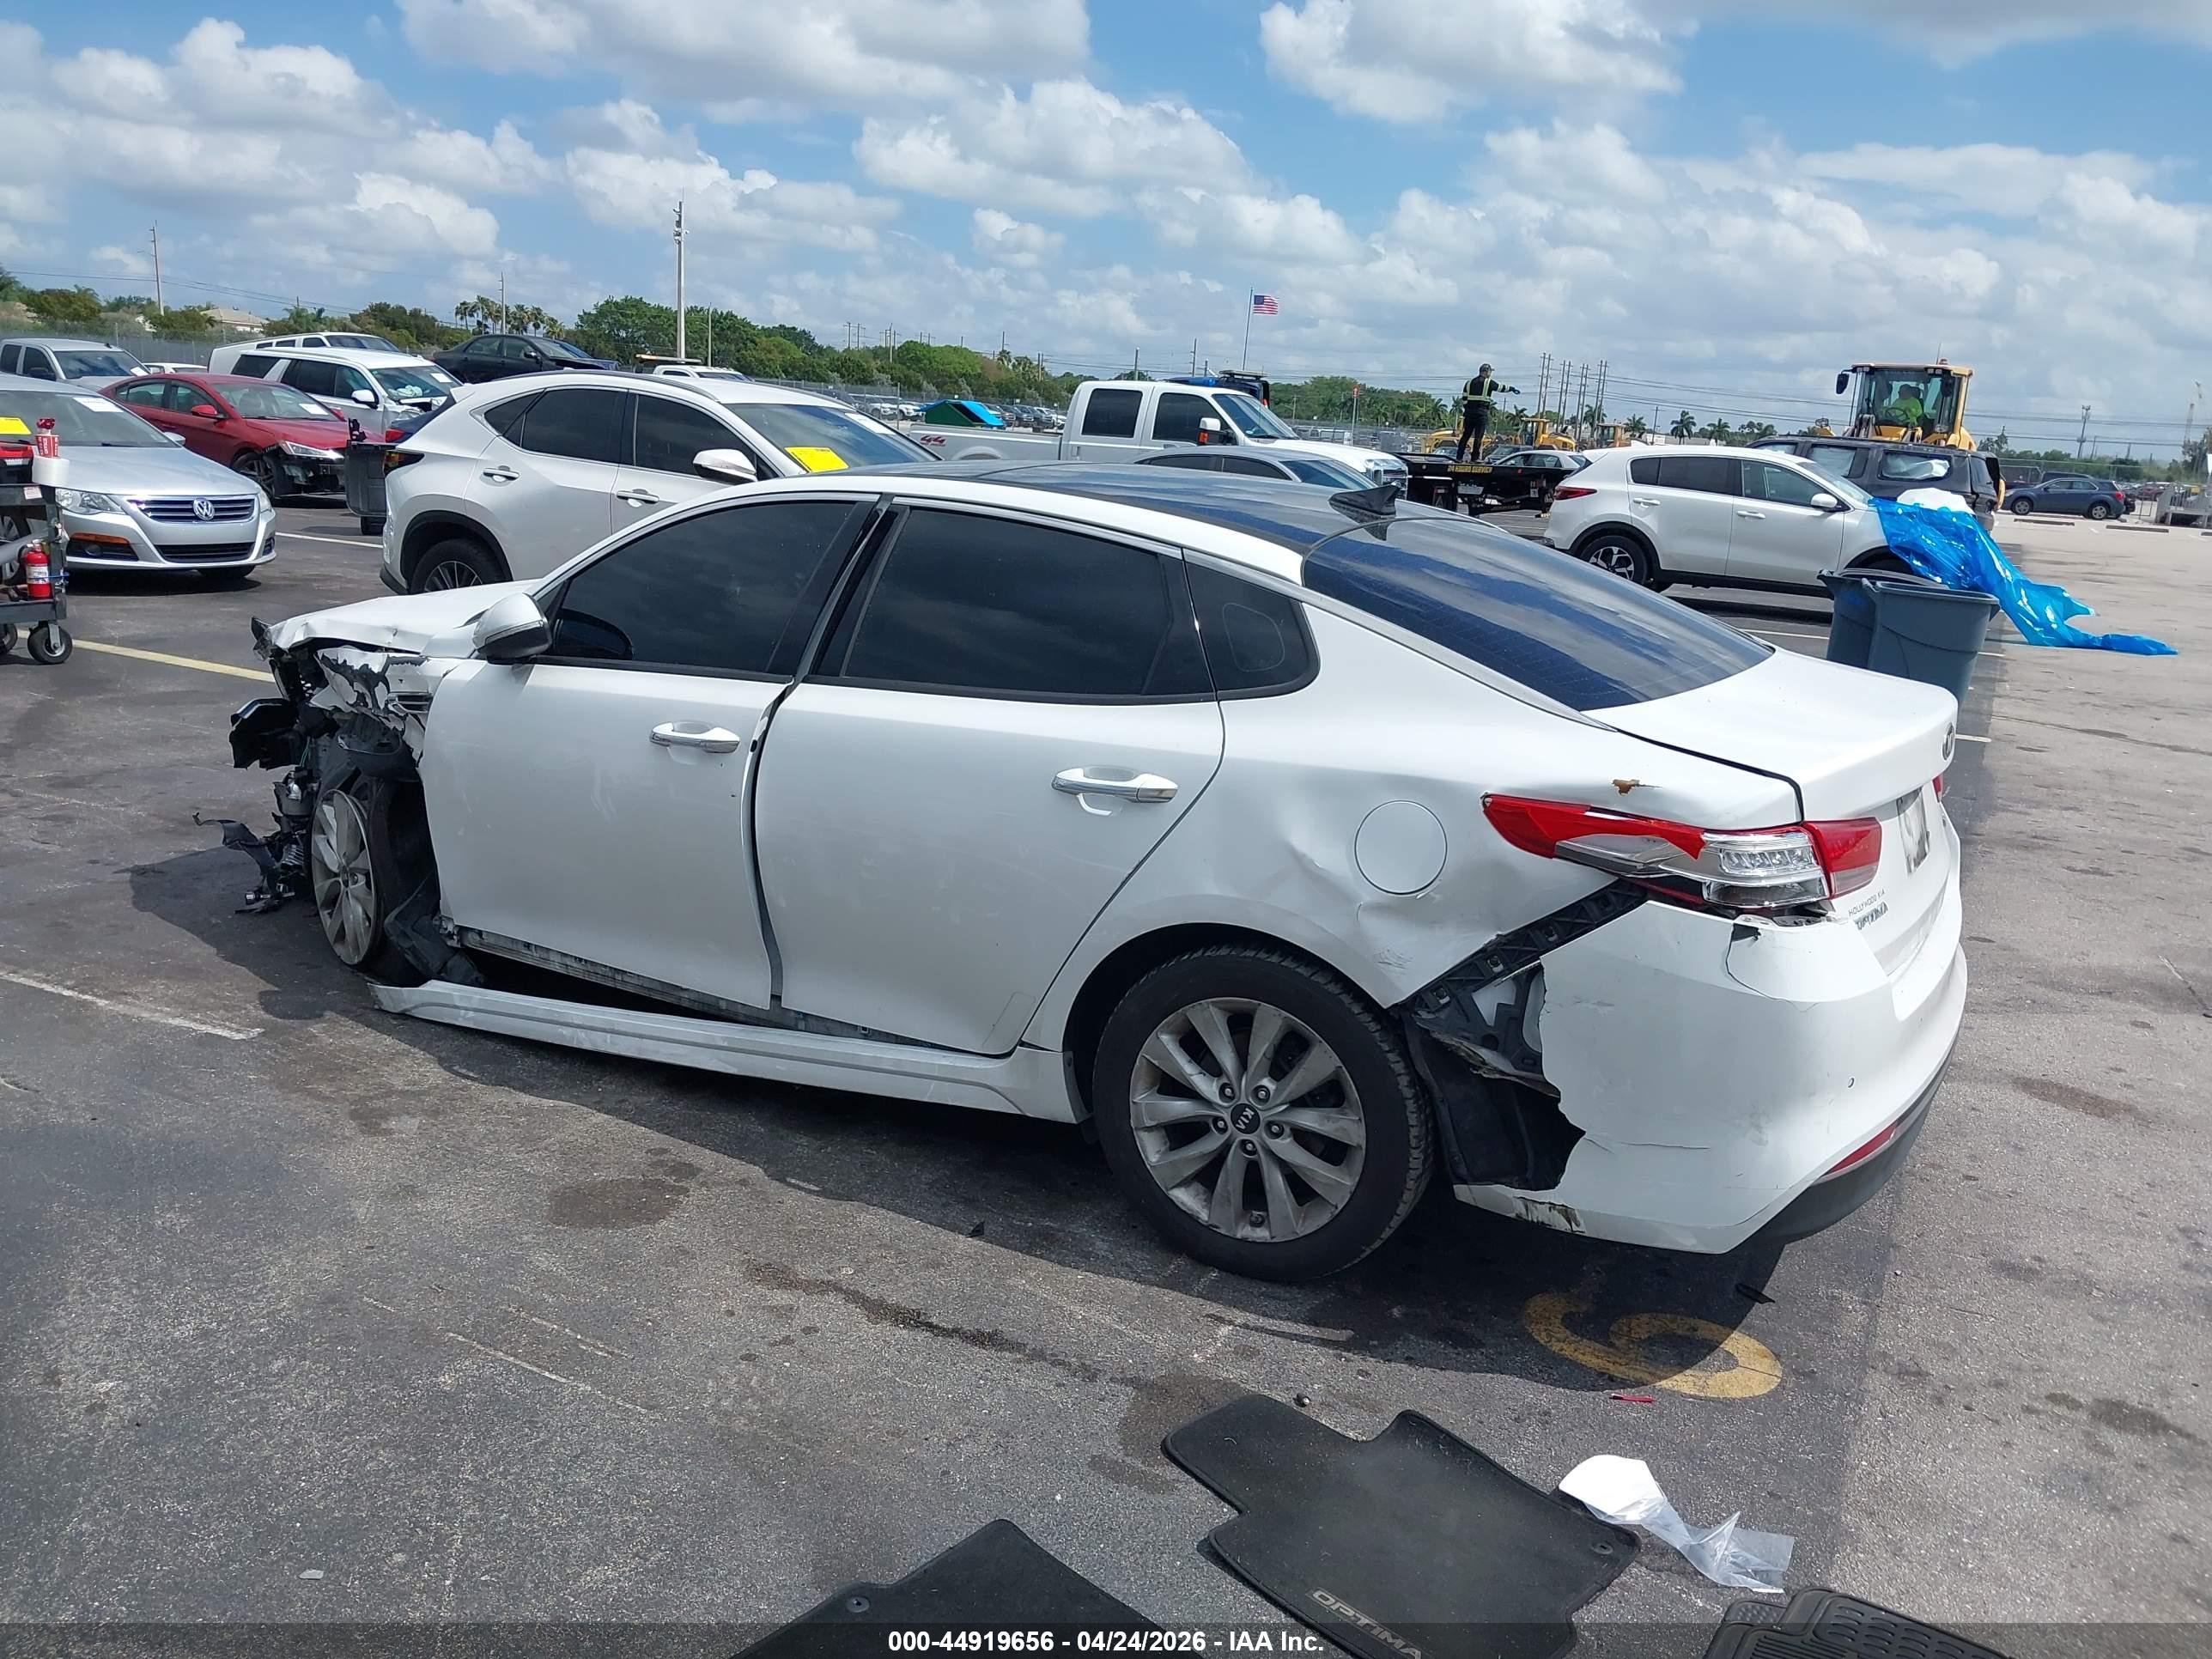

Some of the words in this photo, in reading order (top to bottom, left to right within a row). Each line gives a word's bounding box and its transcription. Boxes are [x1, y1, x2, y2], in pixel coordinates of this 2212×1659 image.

[1849, 894, 1877, 917] HOLLYWOOD
[1236, 1108, 1255, 1130] KIA
[1312, 1589, 1423, 1659] OPTIMA
